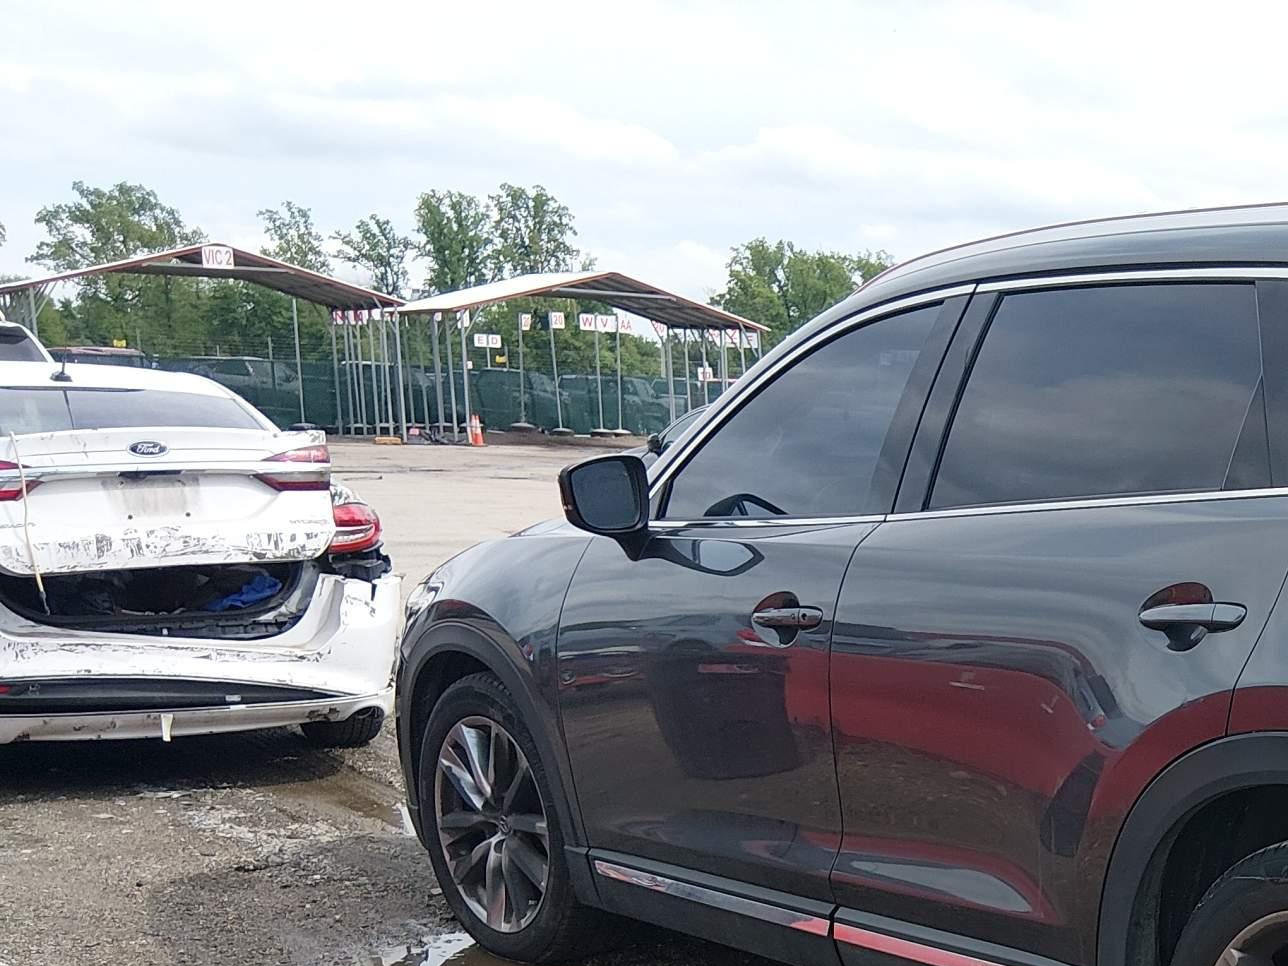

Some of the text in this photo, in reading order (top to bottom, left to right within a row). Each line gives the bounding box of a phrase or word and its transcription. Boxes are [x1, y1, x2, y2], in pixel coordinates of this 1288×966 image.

[203, 248, 232, 265] VIC 2
[553, 314, 563, 325] 20
[582, 316, 593, 327] W
[601, 318, 609, 327] V
[620, 320, 632, 331] AA
[477, 336, 485, 345] E
[491, 337, 498, 345] D
[137, 443, 160, 453] Ford
